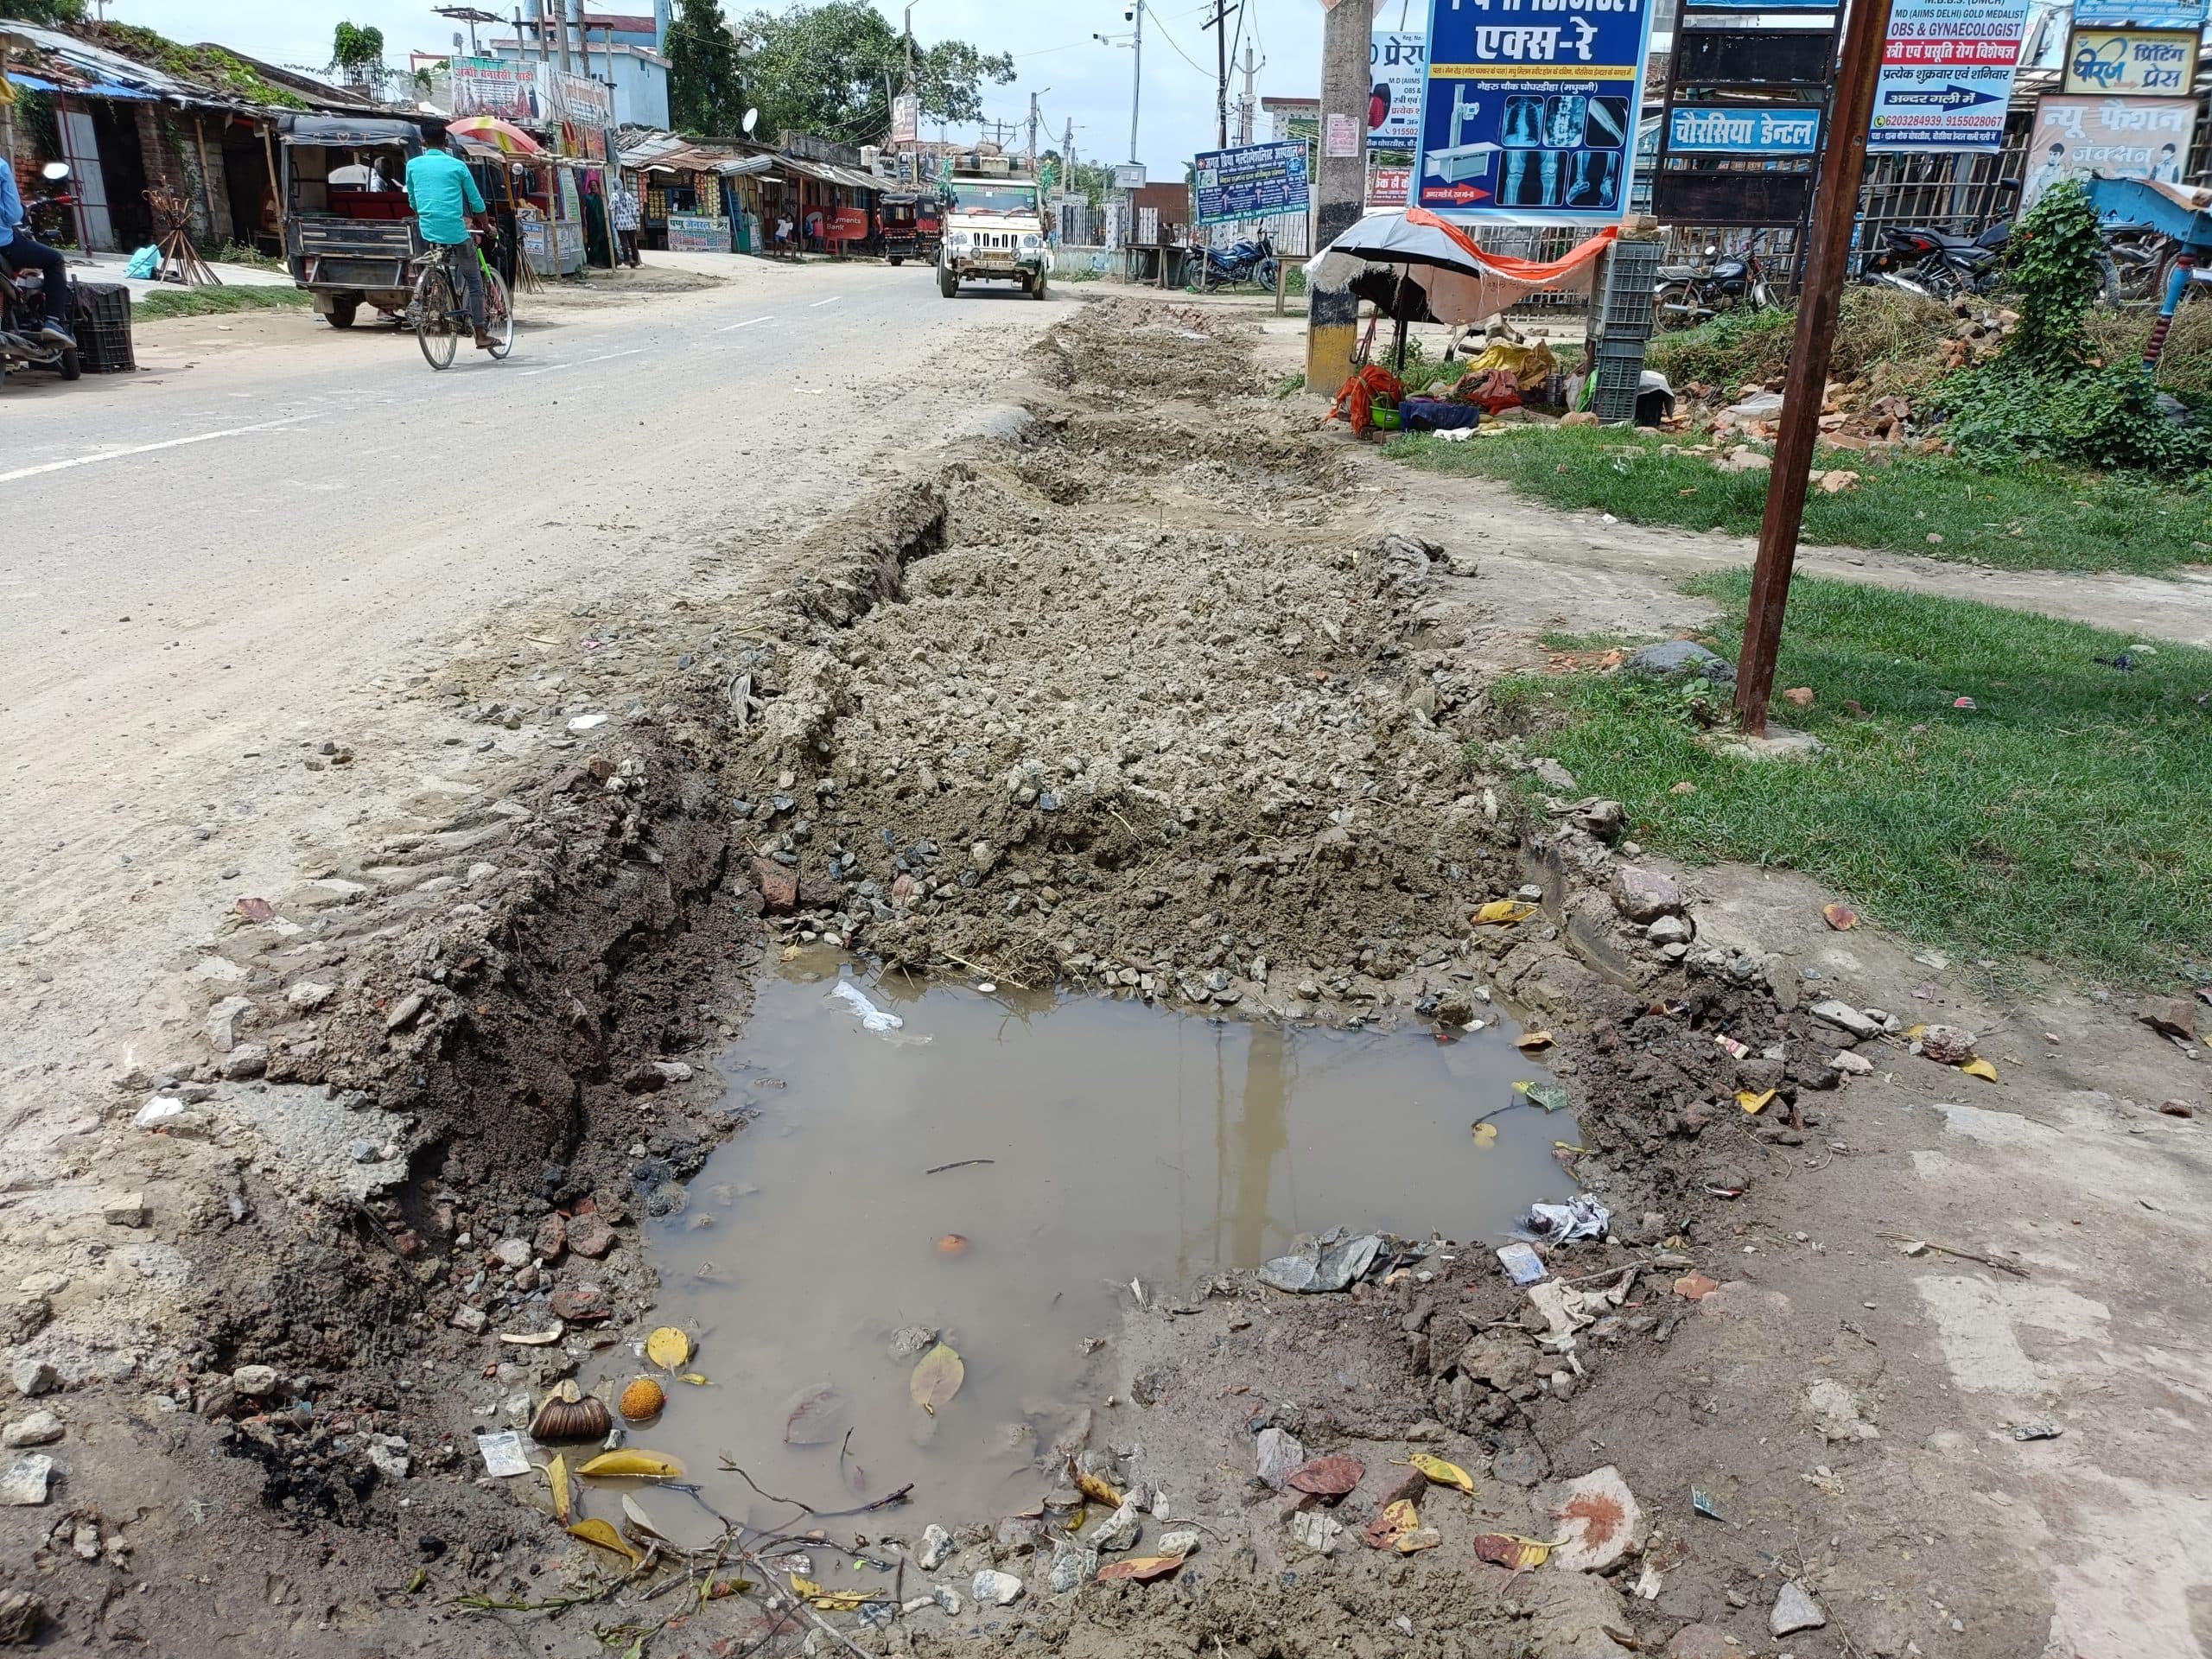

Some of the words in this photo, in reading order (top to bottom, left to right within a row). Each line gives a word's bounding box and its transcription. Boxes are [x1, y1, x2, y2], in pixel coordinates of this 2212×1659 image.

[1895, 9, 1907, 17] MD
[1909, 9, 1935, 19] (AIIMS
[1936, 10, 1961, 19] DELHI)
[1963, 10, 1984, 18] GOLD
[1985, 10, 2024, 19] MEDALIST
[1891, 22, 1915, 36] OBS
[1917, 22, 1926, 36] &
[1929, 22, 2020, 36] GYNAECOLOGIST
[1886, 41, 1904, 59] स्त्री
[1905, 41, 1923, 58] एवं
[1924, 41, 1954, 63] प्रसूति
[1956, 41, 1974, 59] रोग
[1976, 41, 2017, 60] विशेषज्ञ
[1883, 67, 1915, 80] प्रत्येक
[1916, 67, 1953, 84] शुक्रवार
[1954, 67, 1971, 79] एवं
[1971, 67, 2010, 80] शनिवार
[2142, 63, 2183, 87] प्रेस
[1889, 93, 1927, 104] अन्दर
[1929, 92, 1961, 104] गली
[1962, 92, 1976, 104] में
[1946, 116, 2003, 127] 9155028067
[2043, 105, 2089, 138] न्यू
[2099, 99, 2190, 131] फैशन
[1675, 111, 1755, 144] चौरसिया
[1761, 113, 1815, 144] डेन्टल
